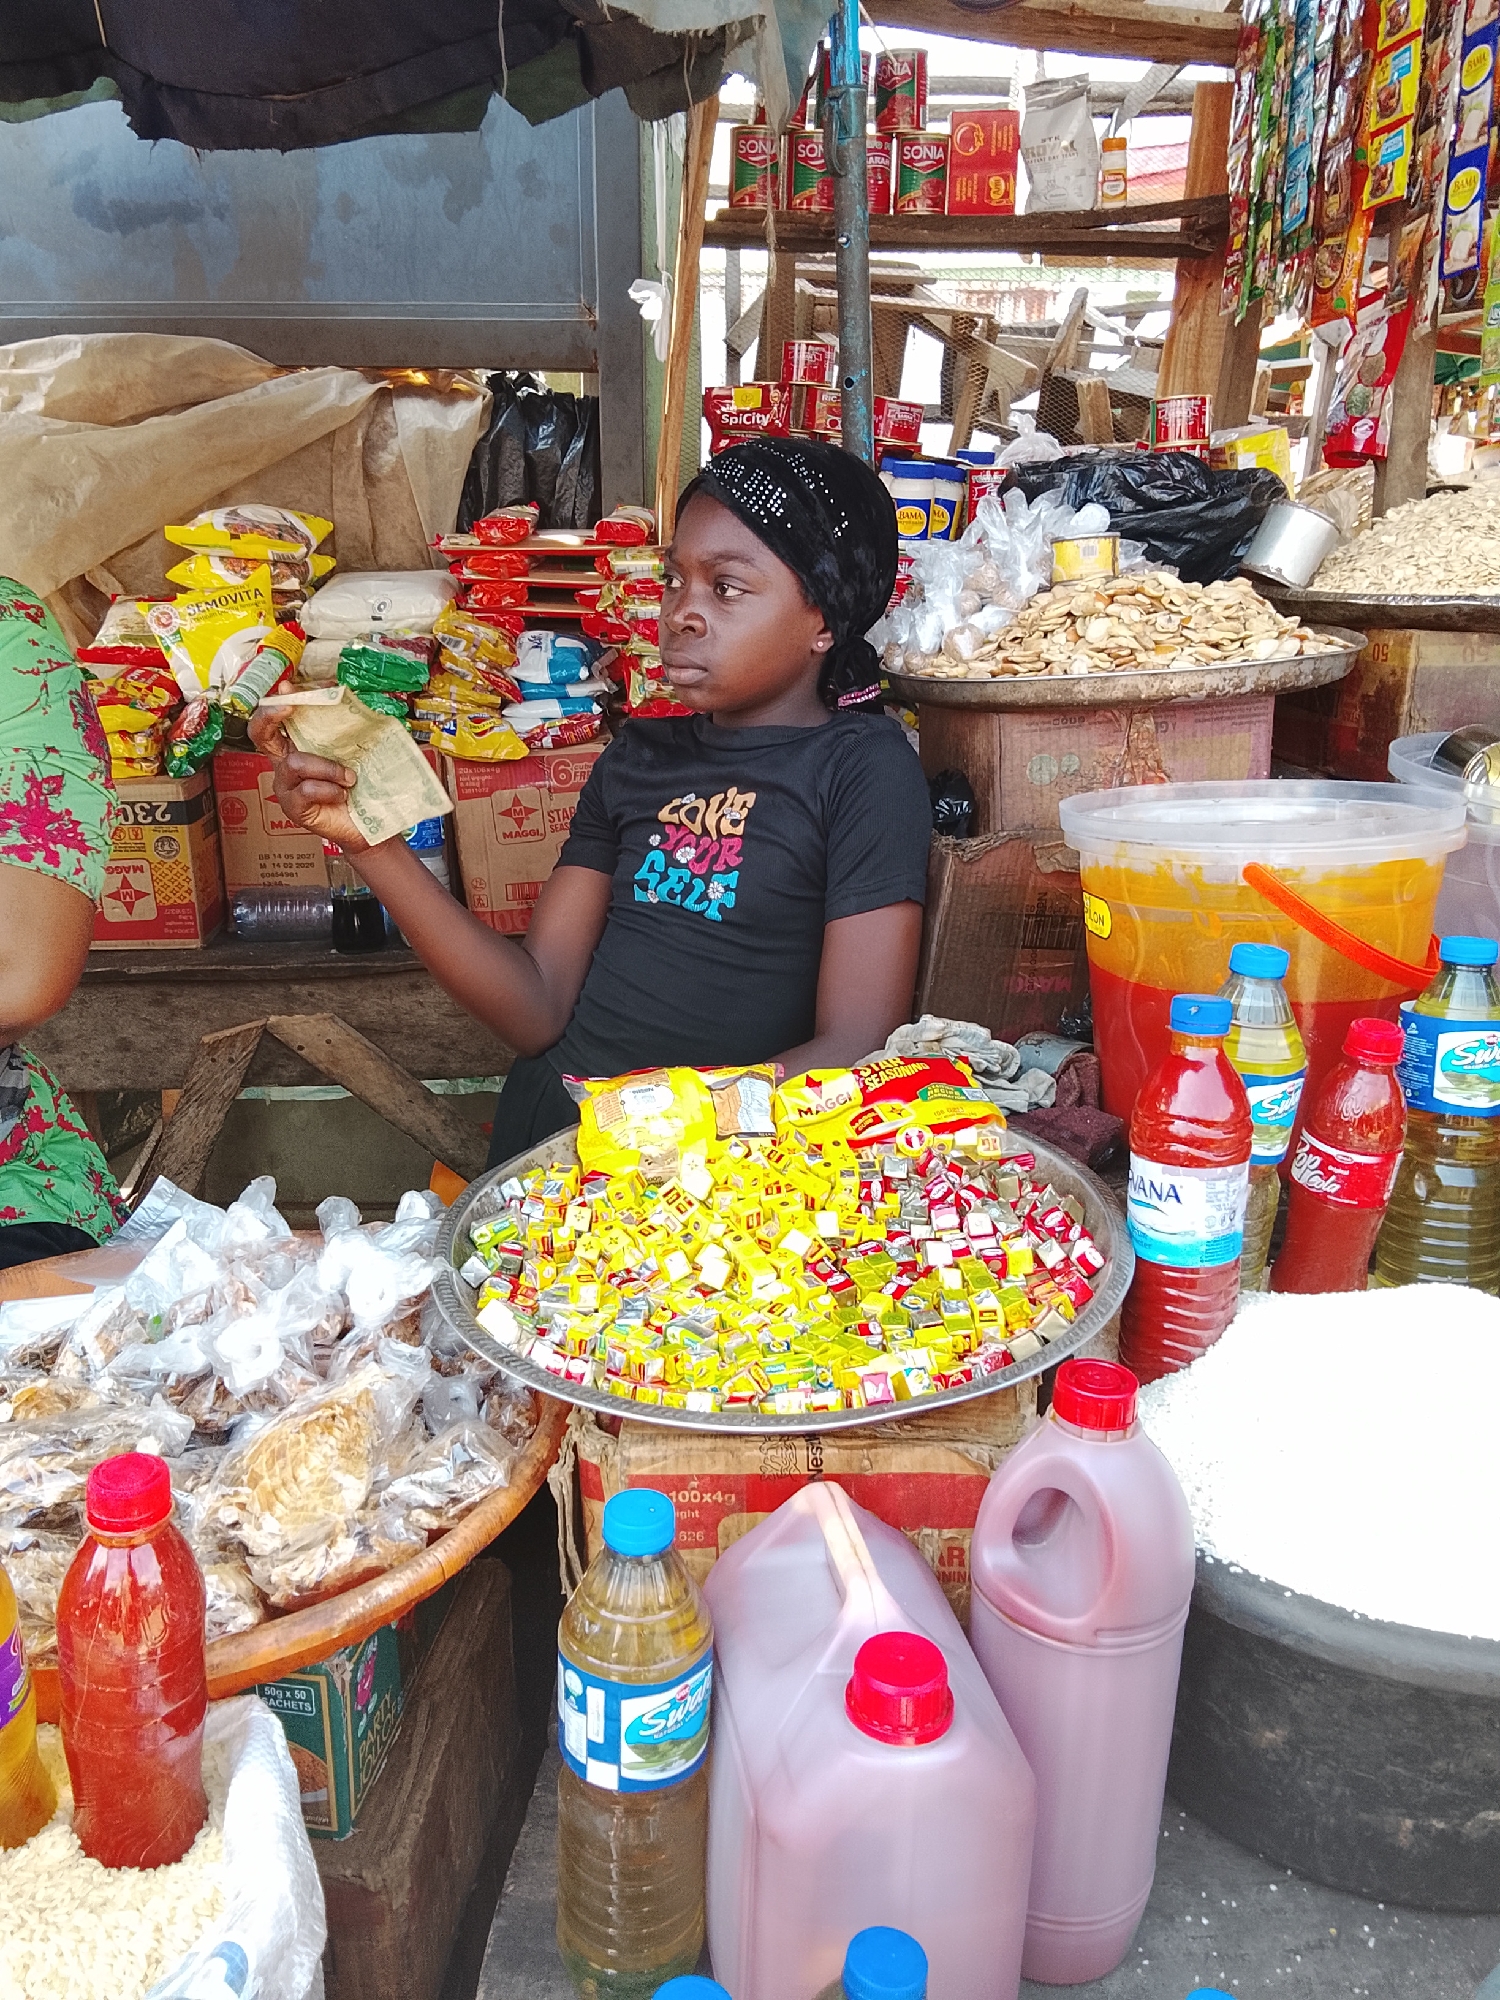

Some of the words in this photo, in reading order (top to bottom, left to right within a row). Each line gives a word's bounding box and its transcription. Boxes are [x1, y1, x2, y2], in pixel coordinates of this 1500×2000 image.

[903, 144, 945, 161] SONIA
[721, 412, 770, 426] SpiCity
[897, 511, 922, 520] BAMA
[933, 509, 945, 518] MA
[186, 587, 264, 616] SEMOVITA
[1372, 642, 1389, 662] 50
[552, 759, 572, 787] 6
[658, 787, 757, 841] LOVE
[550, 822, 571, 834] SEAS
[658, 823, 743, 875] YOUR
[105, 864, 145, 875] MAGG
[633, 849, 739, 922] SELF
[859, 1057, 904, 1080] STAR
[864, 1060, 931, 1092] SEASONING
[797, 1090, 854, 1119] MAGGI
[678, 1531, 705, 1542] 626
[938, 1570, 968, 1583] NIN
[264, 1687, 283, 1699] 50g
[285, 1690, 292, 1698] x
[294, 1689, 306, 1700] 50
[260, 1696, 312, 1712] SACHETS
